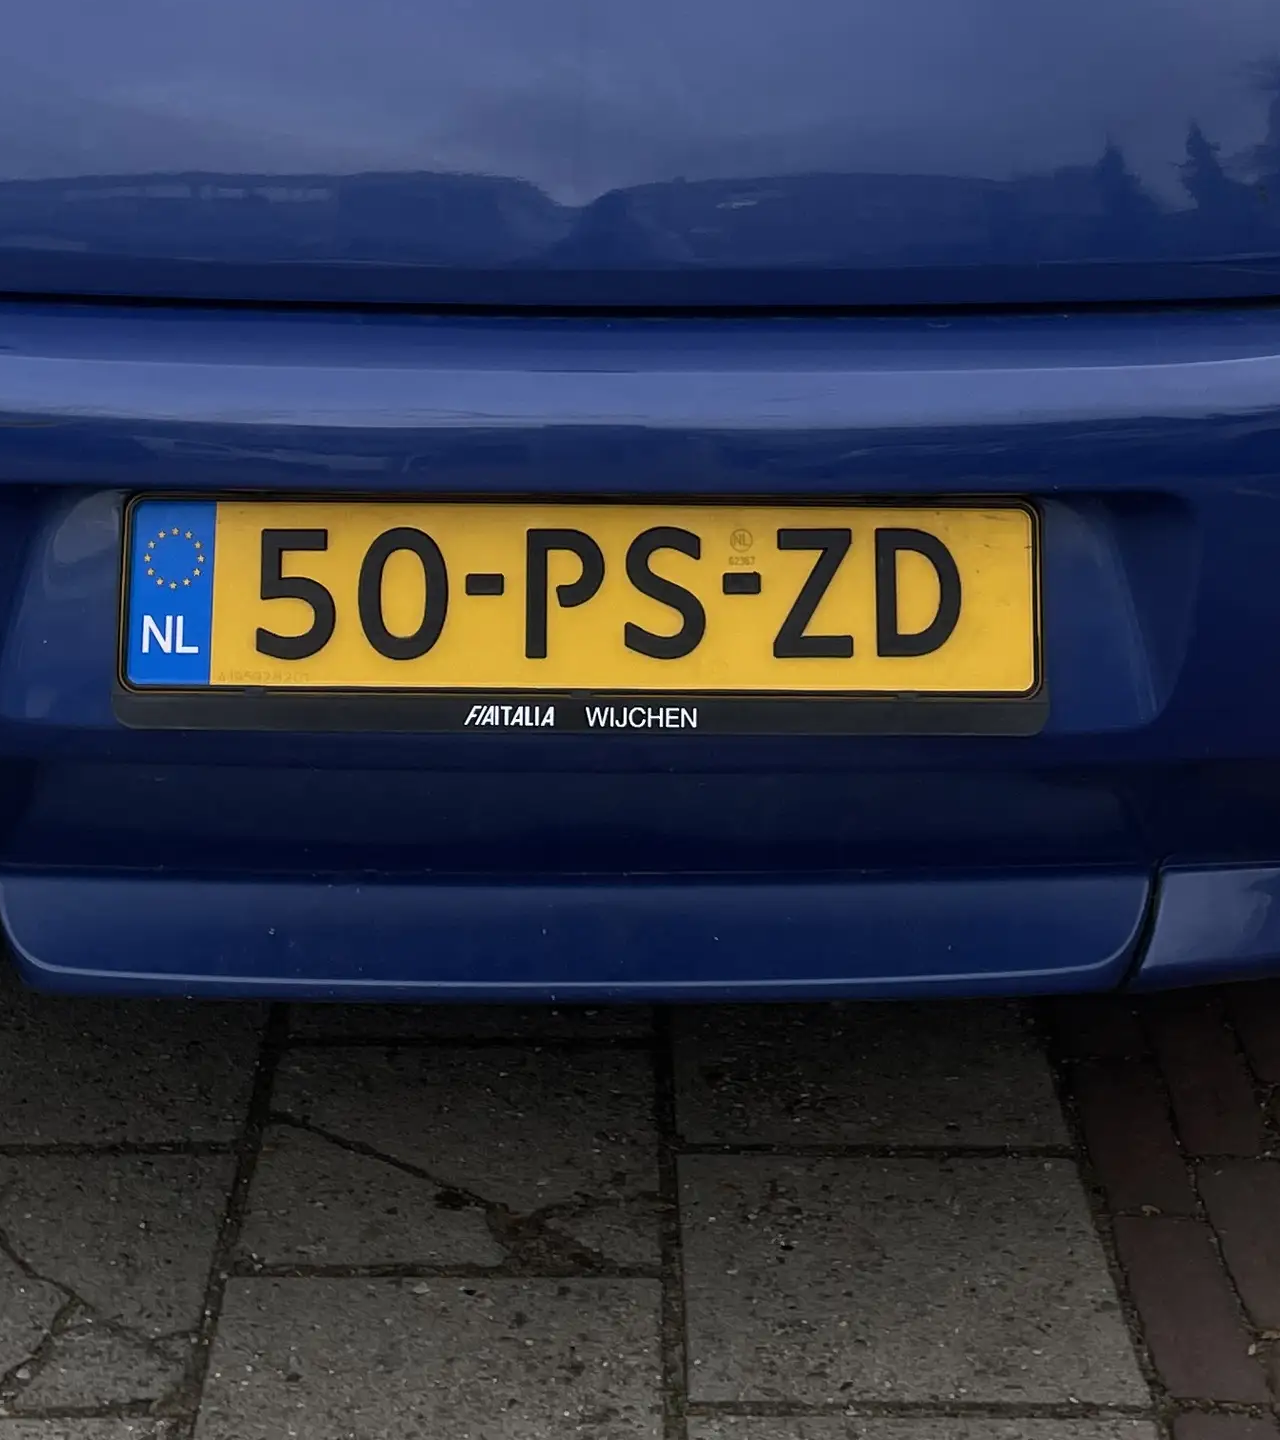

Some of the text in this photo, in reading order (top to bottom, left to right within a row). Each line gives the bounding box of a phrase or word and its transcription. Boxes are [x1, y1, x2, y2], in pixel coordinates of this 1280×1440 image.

[255, 526, 962, 660] 50-PS-ZD
[142, 615, 199, 653] NL
[585, 706, 698, 728] WIJCHEN
